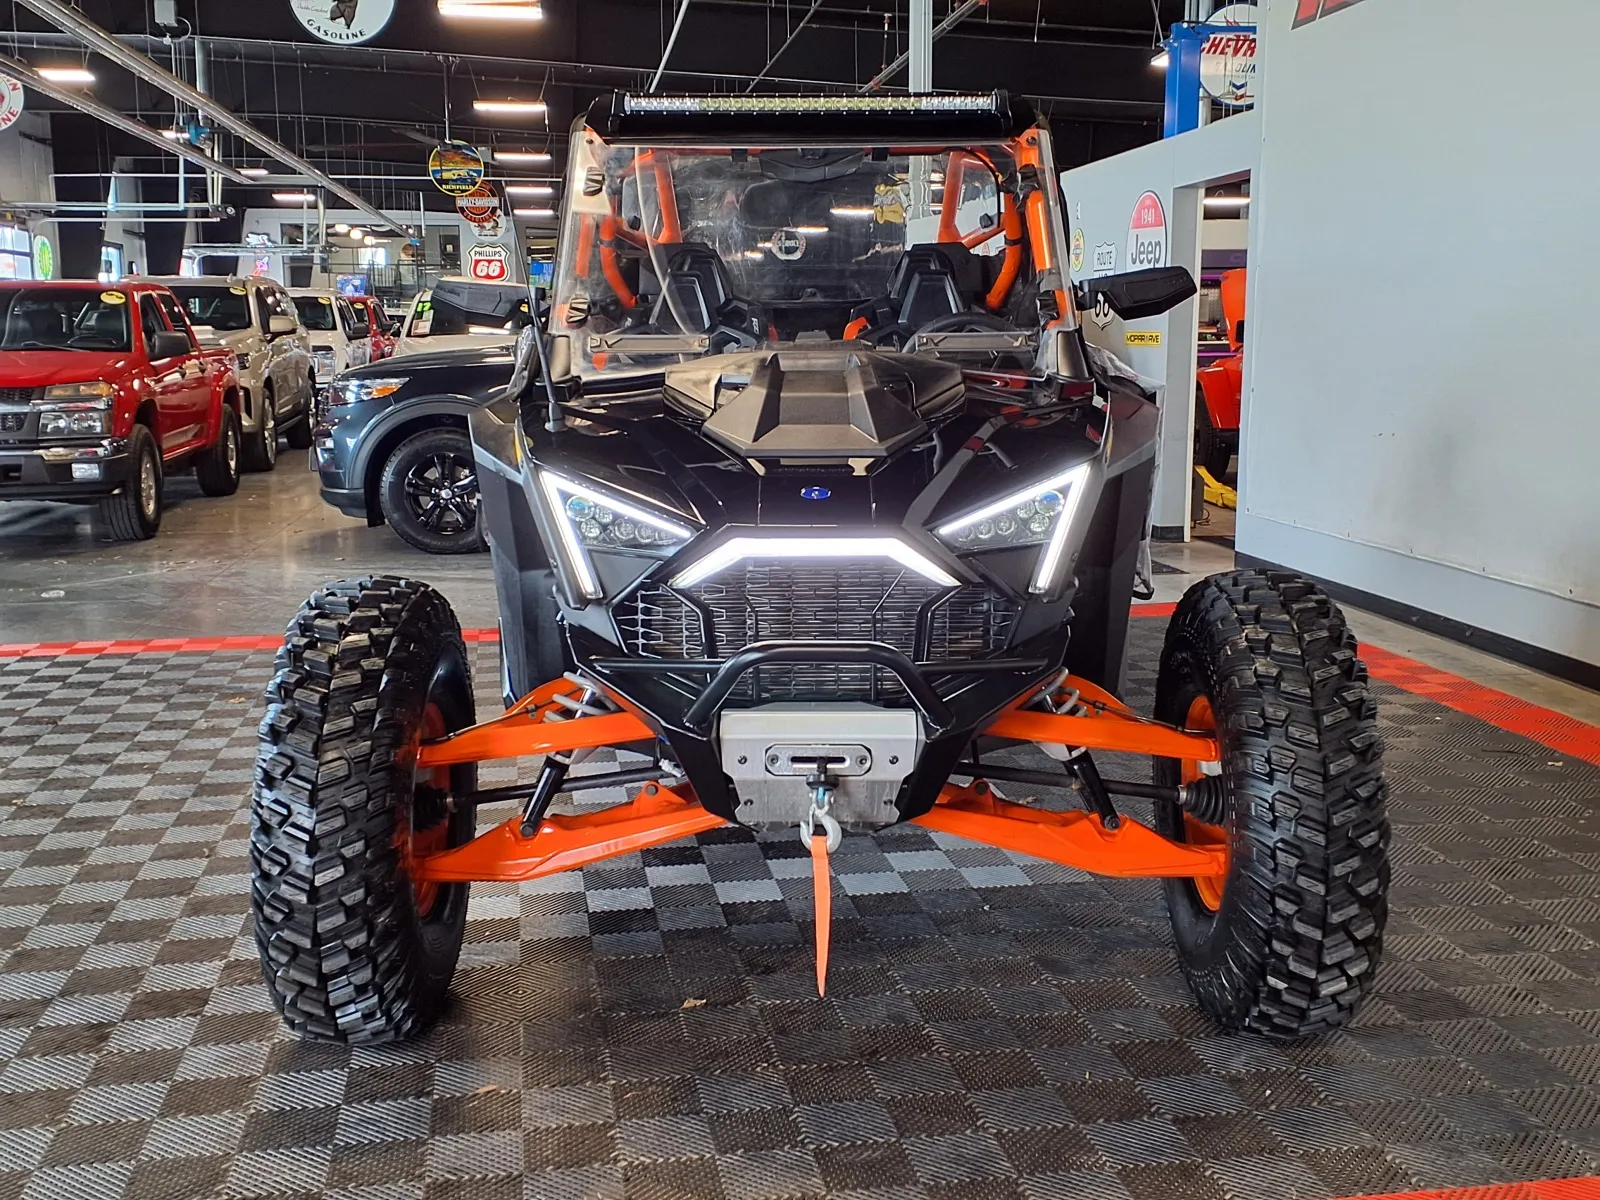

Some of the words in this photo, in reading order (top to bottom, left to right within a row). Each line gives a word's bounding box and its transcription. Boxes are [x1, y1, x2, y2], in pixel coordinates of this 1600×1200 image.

[306, 18, 367, 40] GASOLINE
[1141, 207, 1155, 225] 1941
[1097, 250, 1113, 266] ROUTE
[1131, 233, 1162, 268] Jeep
[476, 260, 502, 277] 66
[1126, 334, 1145, 343] MOPAR
